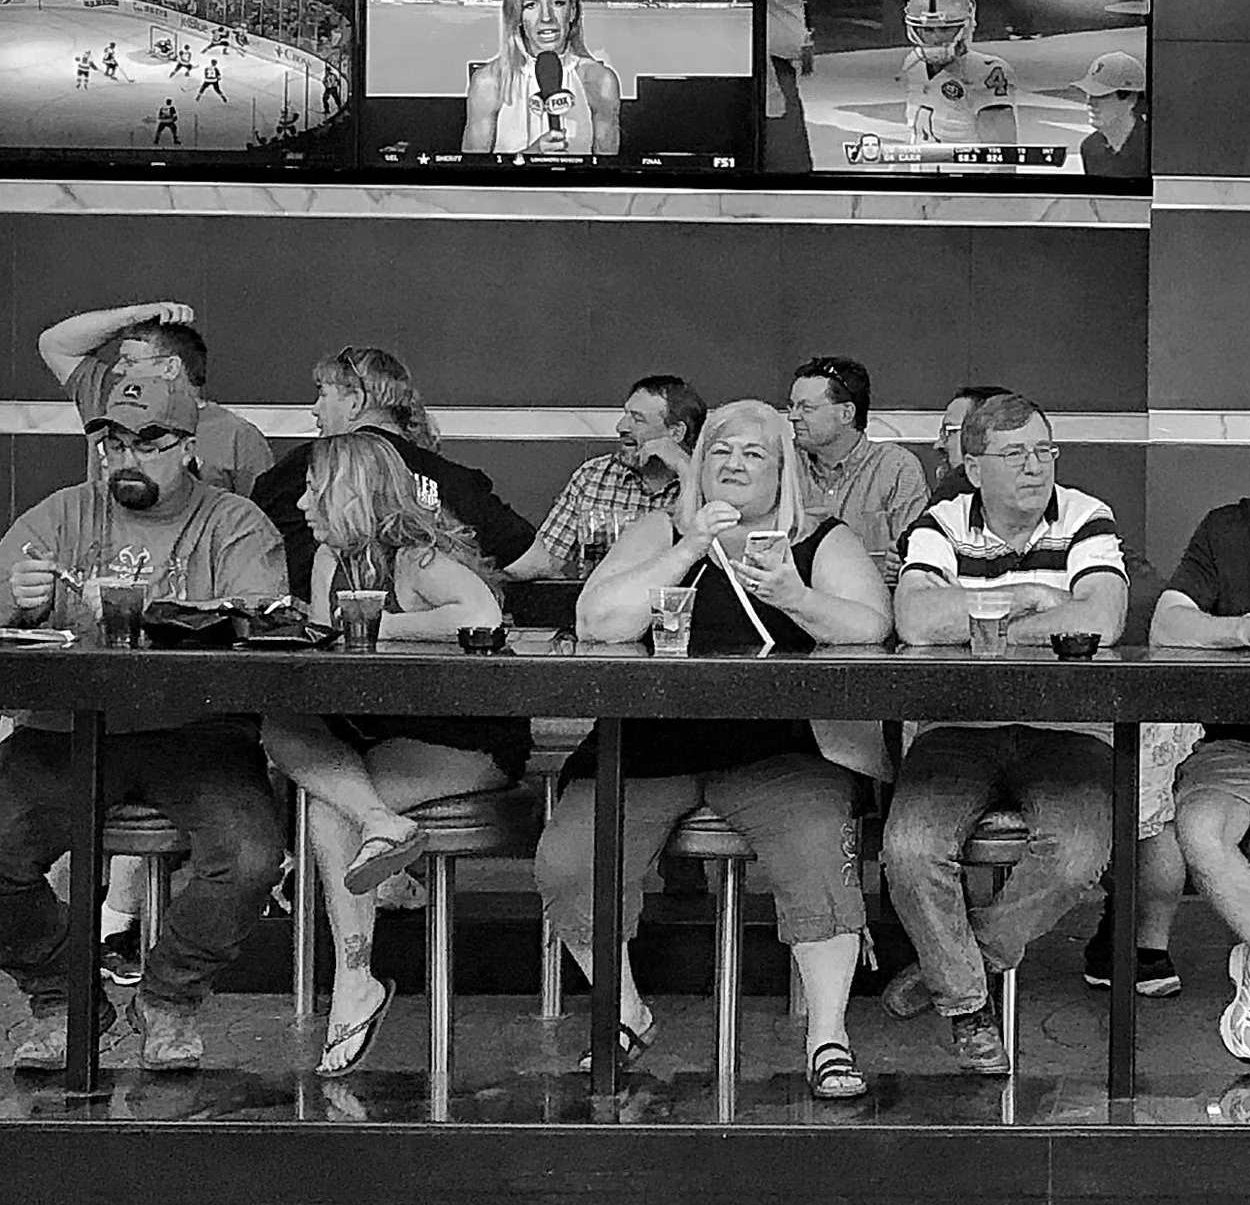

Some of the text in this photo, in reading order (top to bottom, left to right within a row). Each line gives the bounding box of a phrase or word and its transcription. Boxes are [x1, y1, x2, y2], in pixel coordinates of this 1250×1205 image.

[984, 66, 1009, 96] 4
[552, 97, 569, 107] FOX
[713, 157, 735, 168] FS1
[898, 154, 922, 162] CARR
